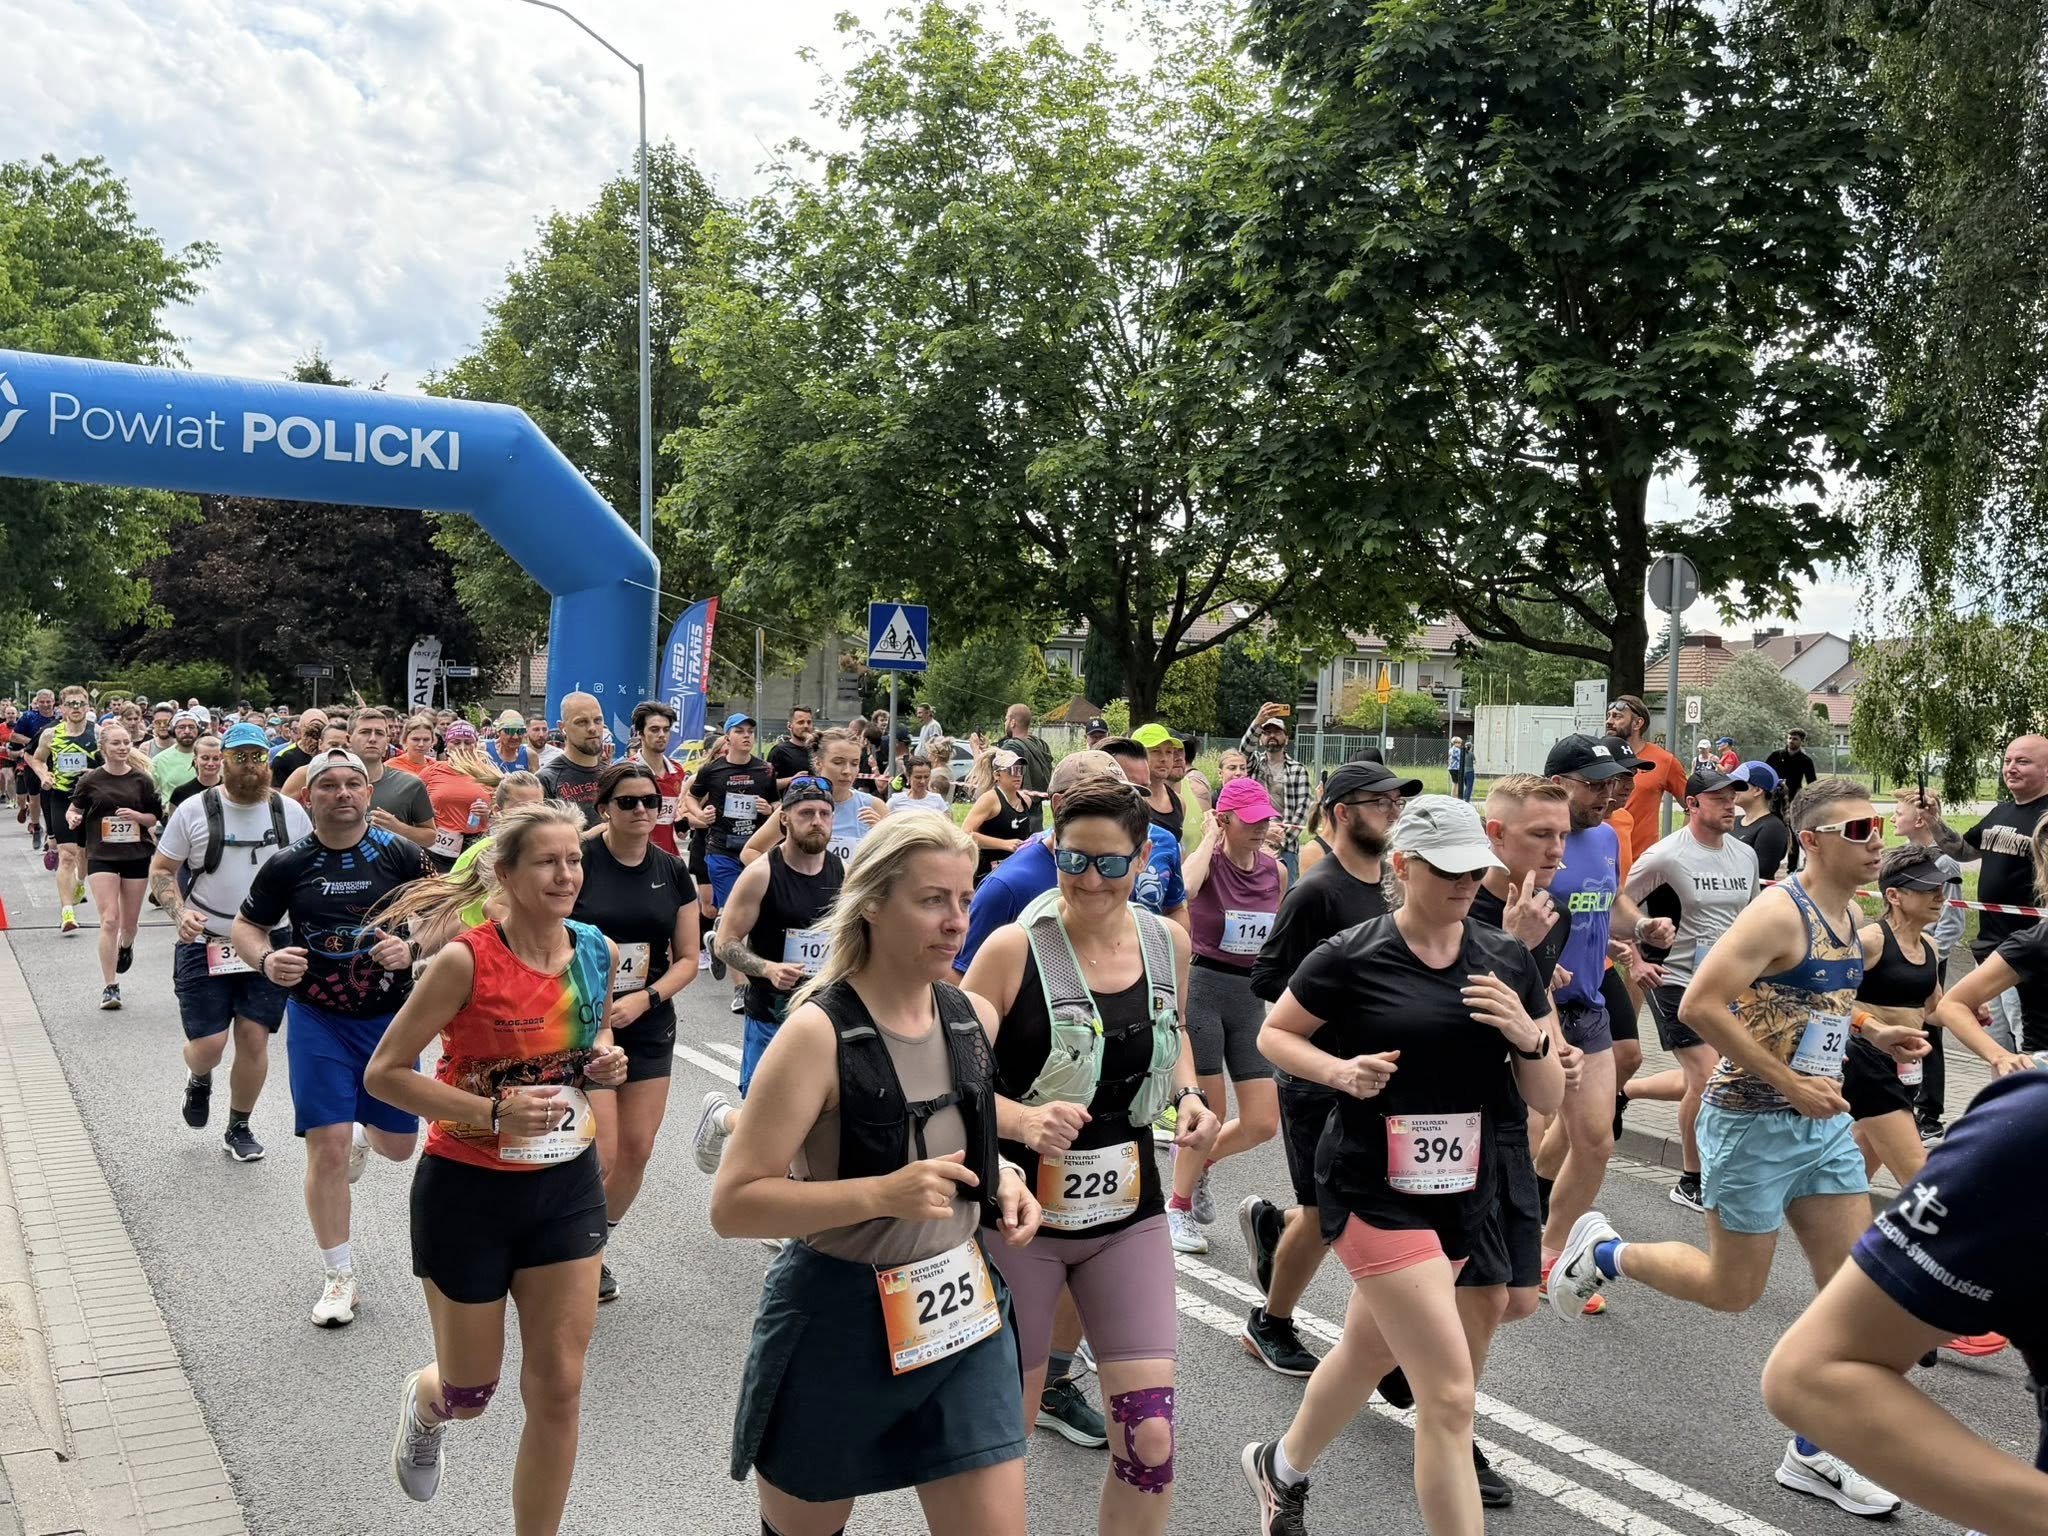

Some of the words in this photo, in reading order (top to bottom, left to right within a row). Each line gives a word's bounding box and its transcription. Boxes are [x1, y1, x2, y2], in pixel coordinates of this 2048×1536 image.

[49, 391, 226, 452] Powiat
[243, 411, 460, 471] POLICKI
[671, 642, 686, 682] MED
[687, 623, 703, 685] TRANS
[413, 664, 432, 706] ART
[63, 757, 80, 766] 116
[733, 801, 752, 810] 115
[110, 823, 132, 833] 237
[435, 834, 455, 847] 367
[832, 846, 850, 860] 40
[1693, 877, 1719, 890] THE
[1721, 877, 1748, 890] LINE
[1239, 923, 1267, 939] 114
[1822, 1032, 1842, 1053] 32
[1413, 1137, 1463, 1163] 396
[1063, 1170, 1119, 1199] 228
[916, 1272, 975, 1326] 225
